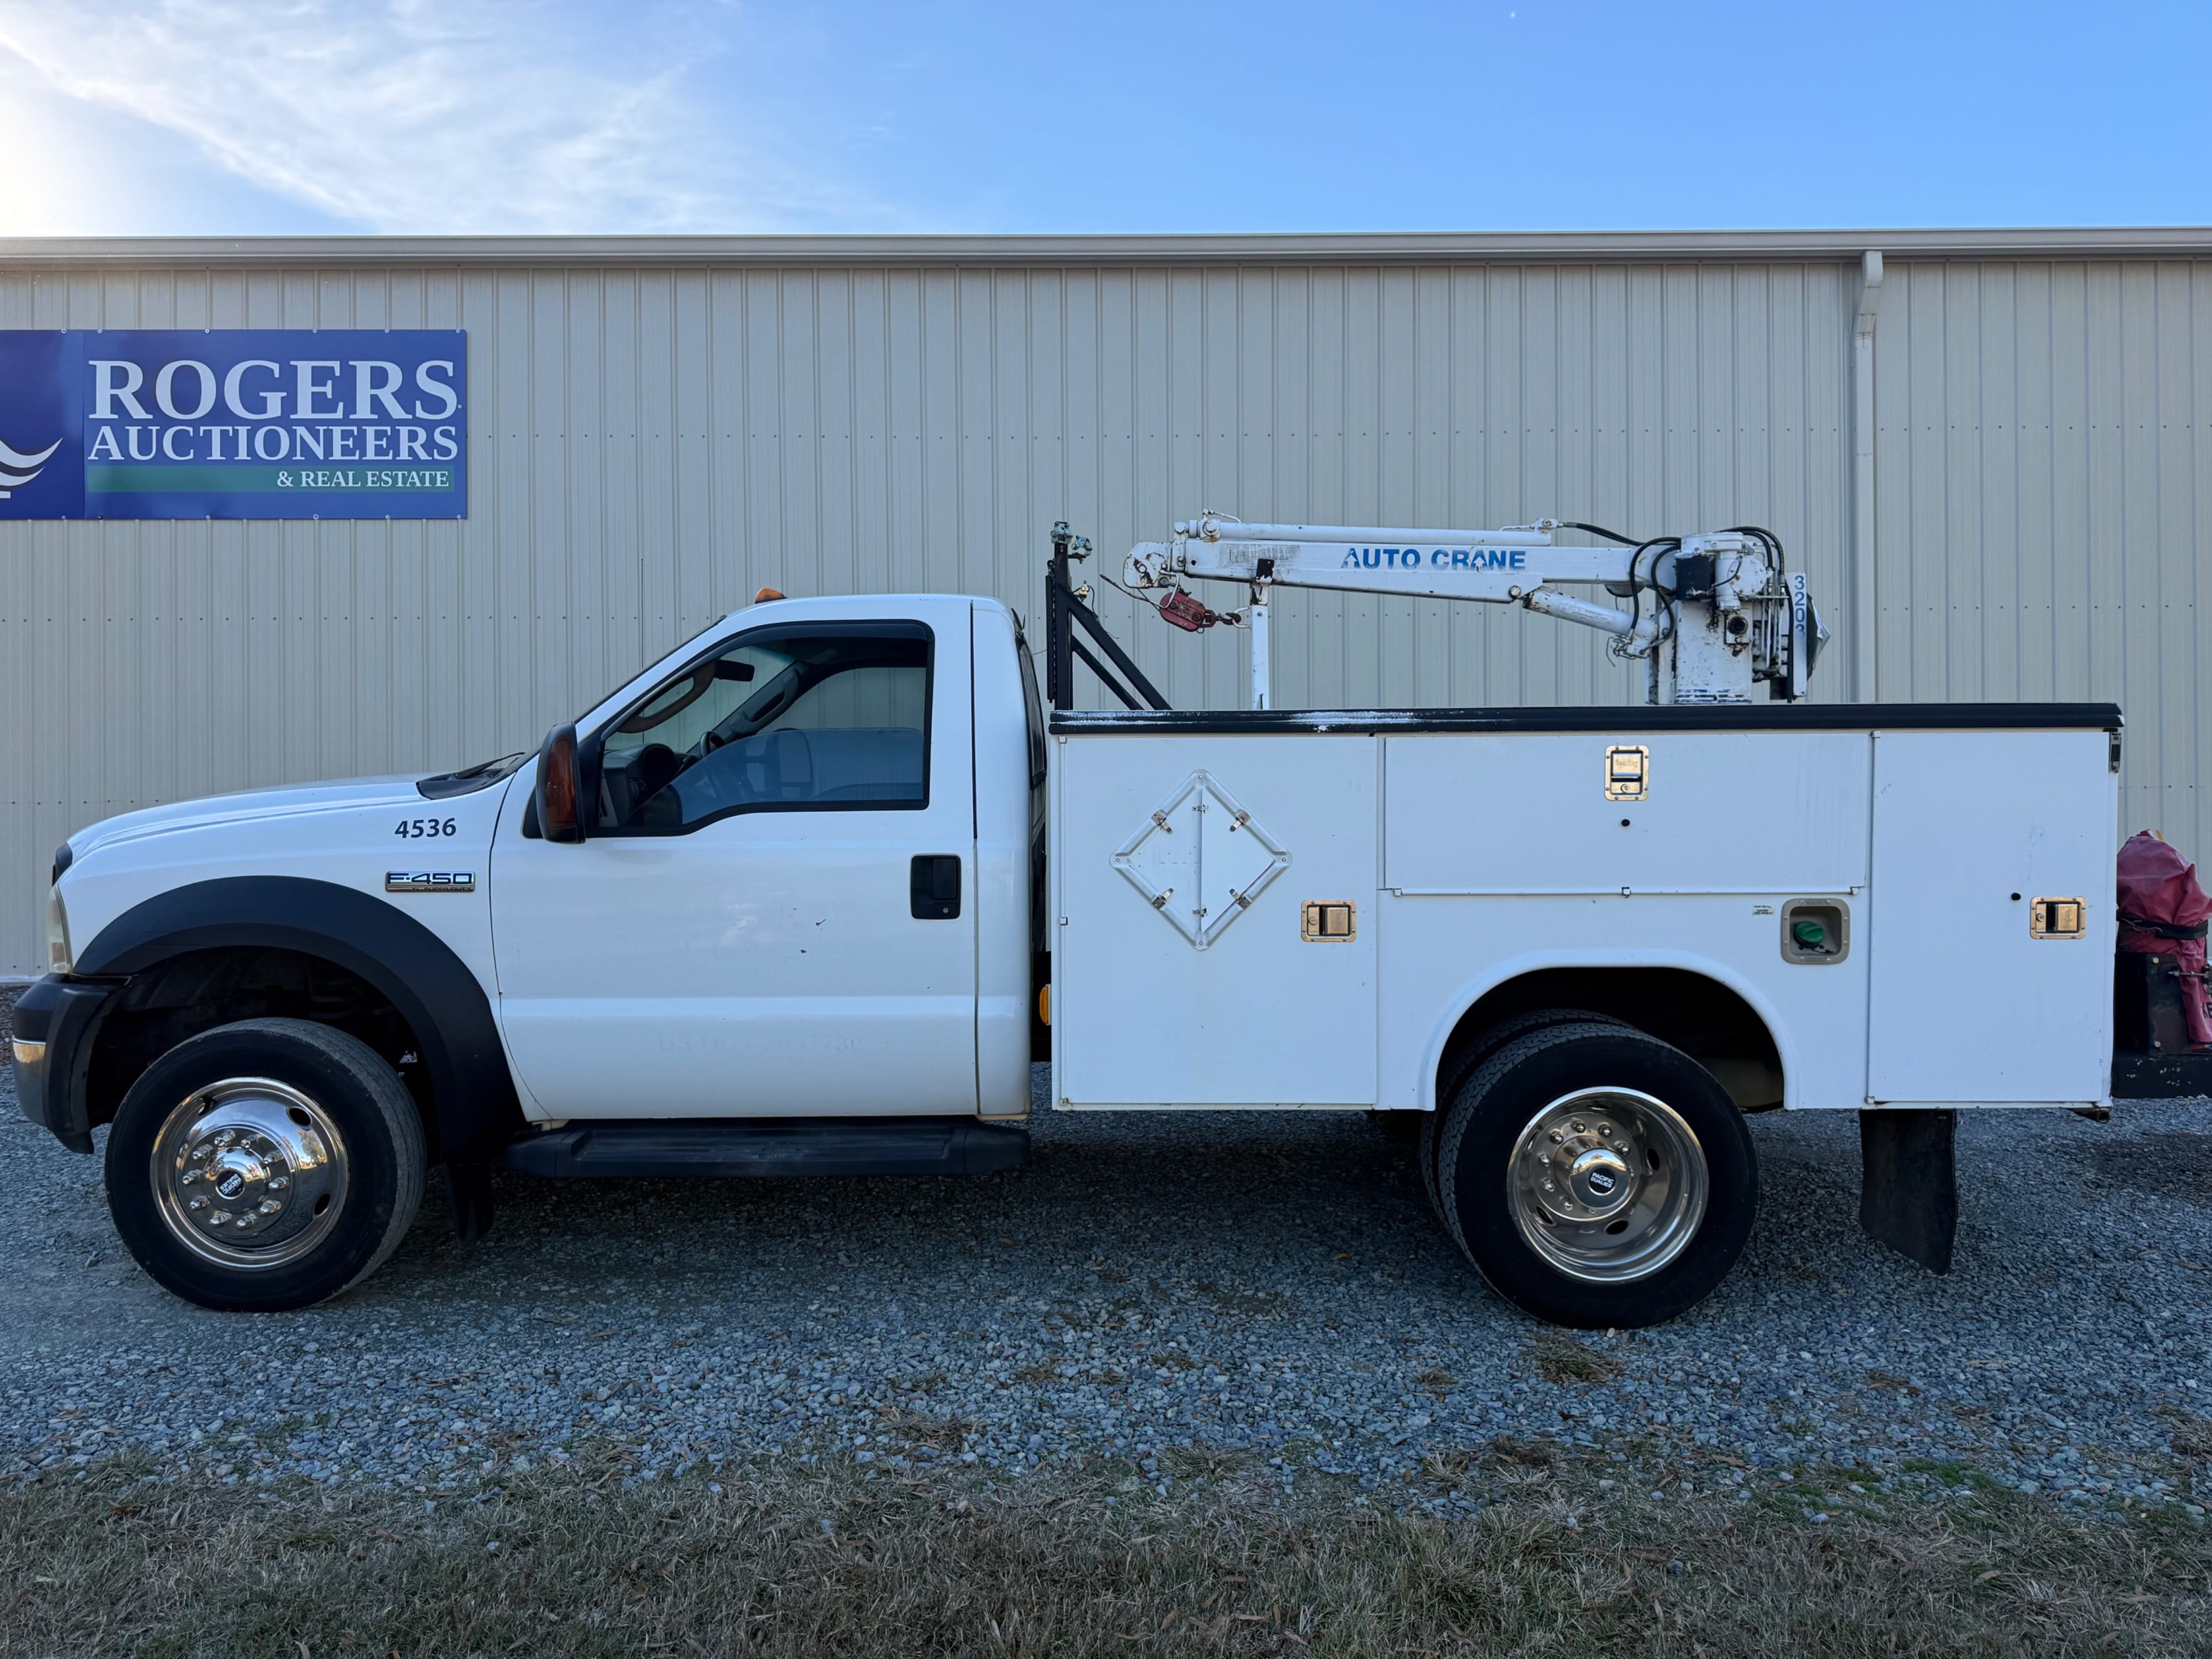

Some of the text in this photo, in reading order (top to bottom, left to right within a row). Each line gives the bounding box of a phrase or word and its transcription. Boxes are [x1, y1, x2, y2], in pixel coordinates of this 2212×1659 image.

[89, 359, 458, 420] ROGERS
[87, 425, 459, 461] AUCTIONEERS
[277, 471, 449, 488] & REAL ESTATE
[1341, 547, 1526, 571] AUTO CRANE
[394, 817, 457, 838] 4536
[387, 873, 472, 884] F-450
